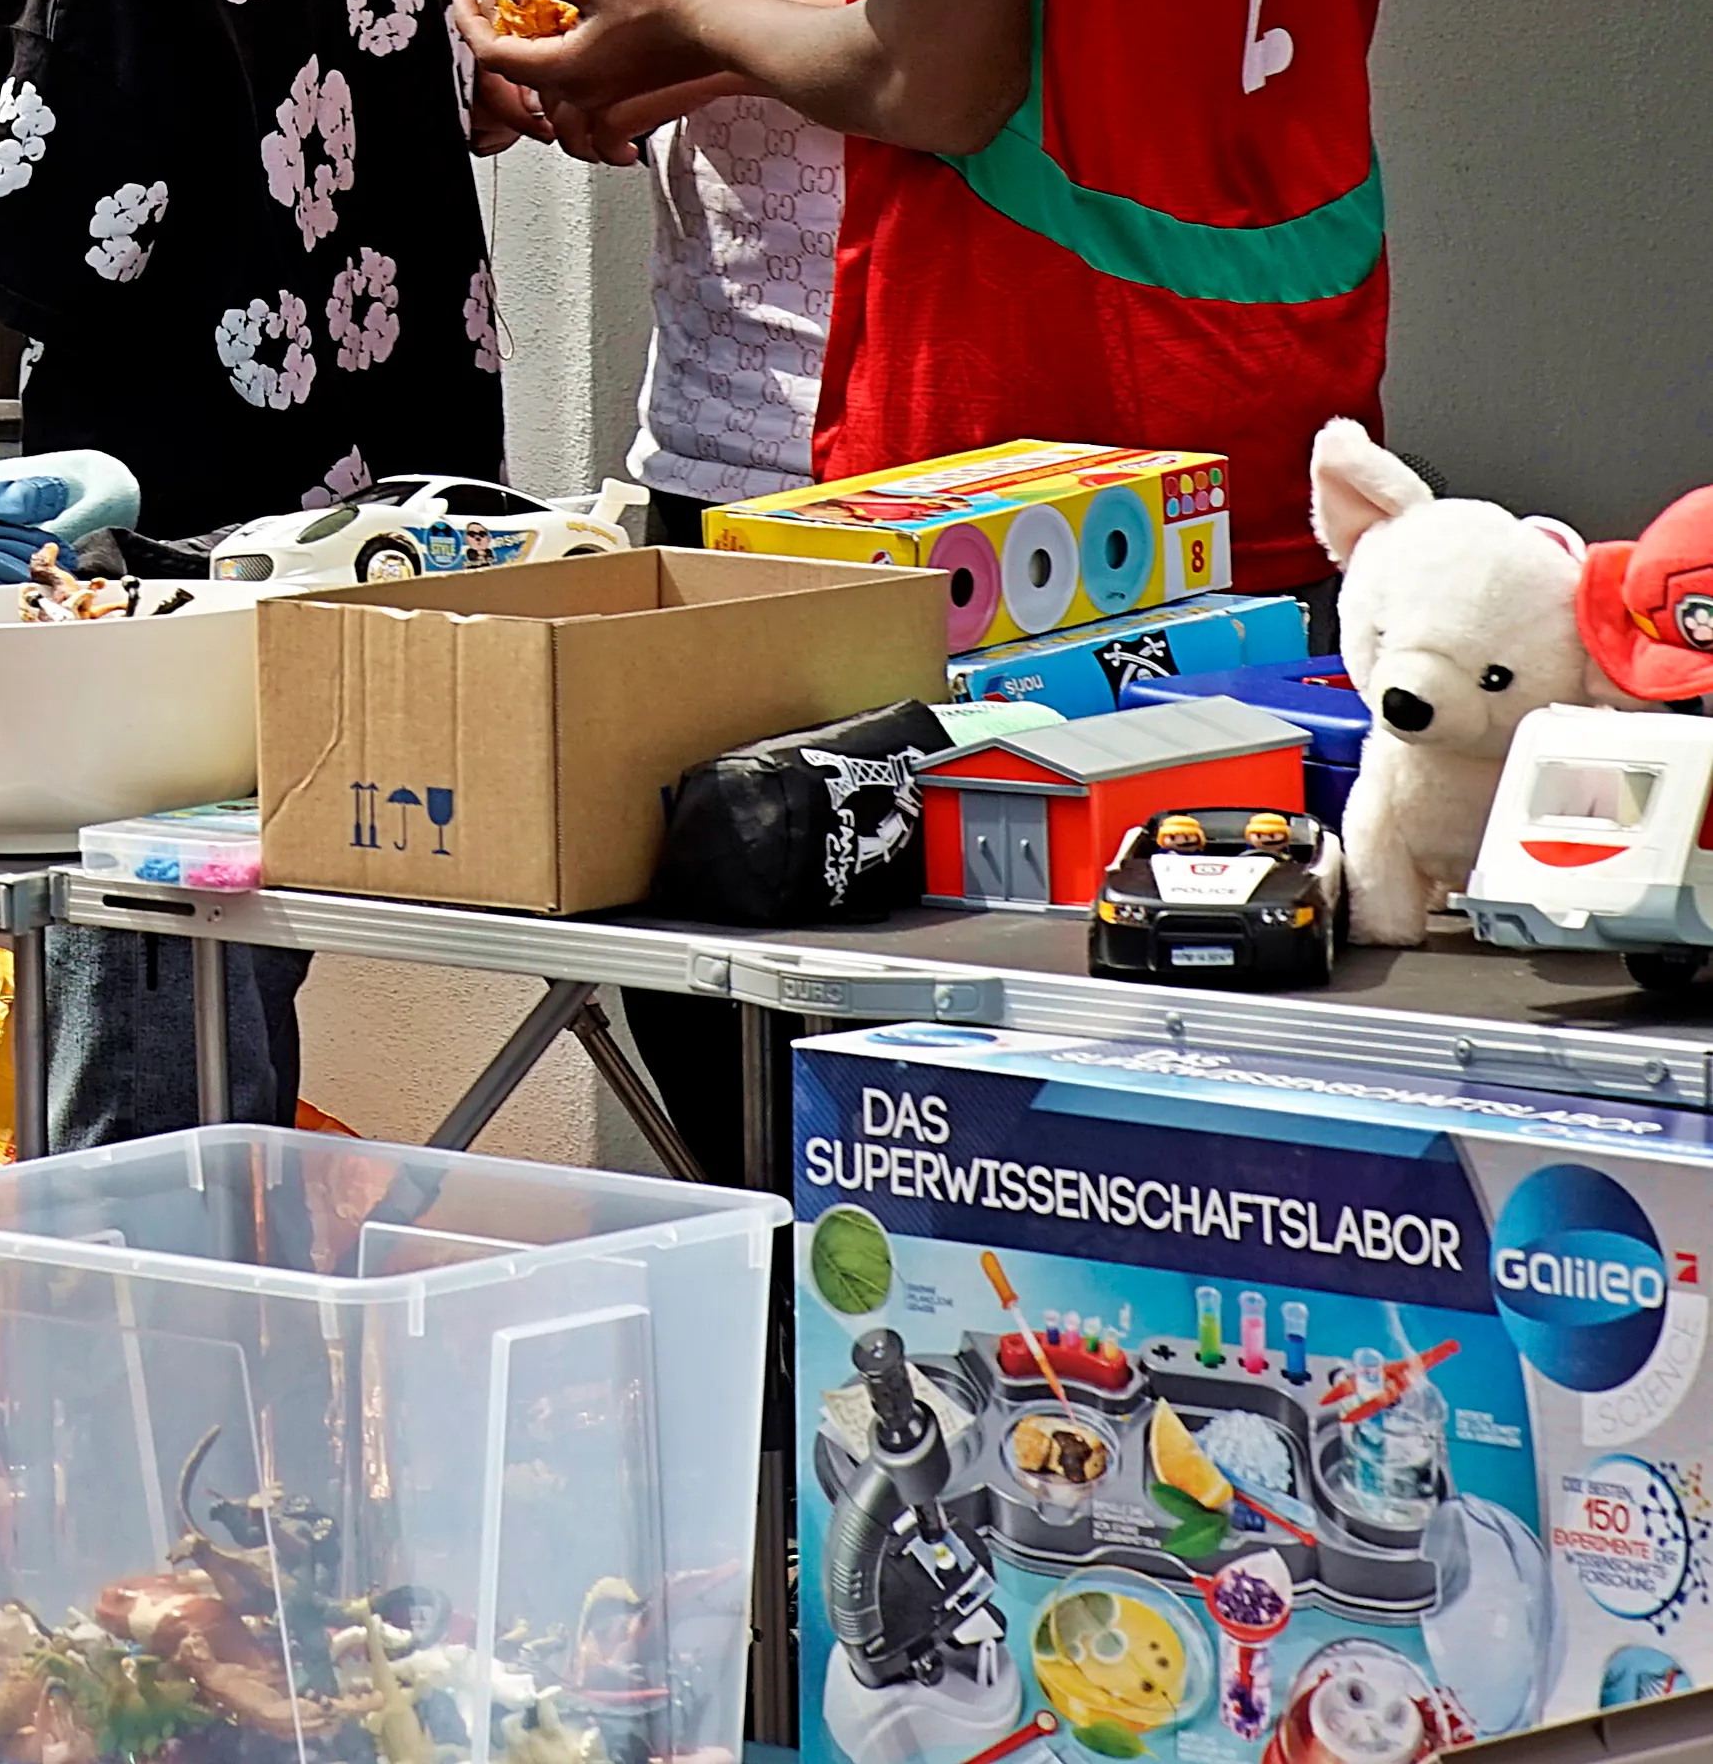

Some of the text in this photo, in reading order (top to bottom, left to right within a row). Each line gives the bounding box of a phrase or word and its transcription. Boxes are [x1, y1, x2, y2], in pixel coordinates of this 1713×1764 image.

[1190, 538, 1205, 574] 8
[1171, 887, 1238, 896] POLICE
[862, 1088, 950, 1144] DAS
[806, 1138, 1463, 1271] SUPERWISSENSCHAFTSLABOR
[1583, 1497, 1631, 1535] 150
[1552, 1527, 1651, 1561] EXPERIMENTE
